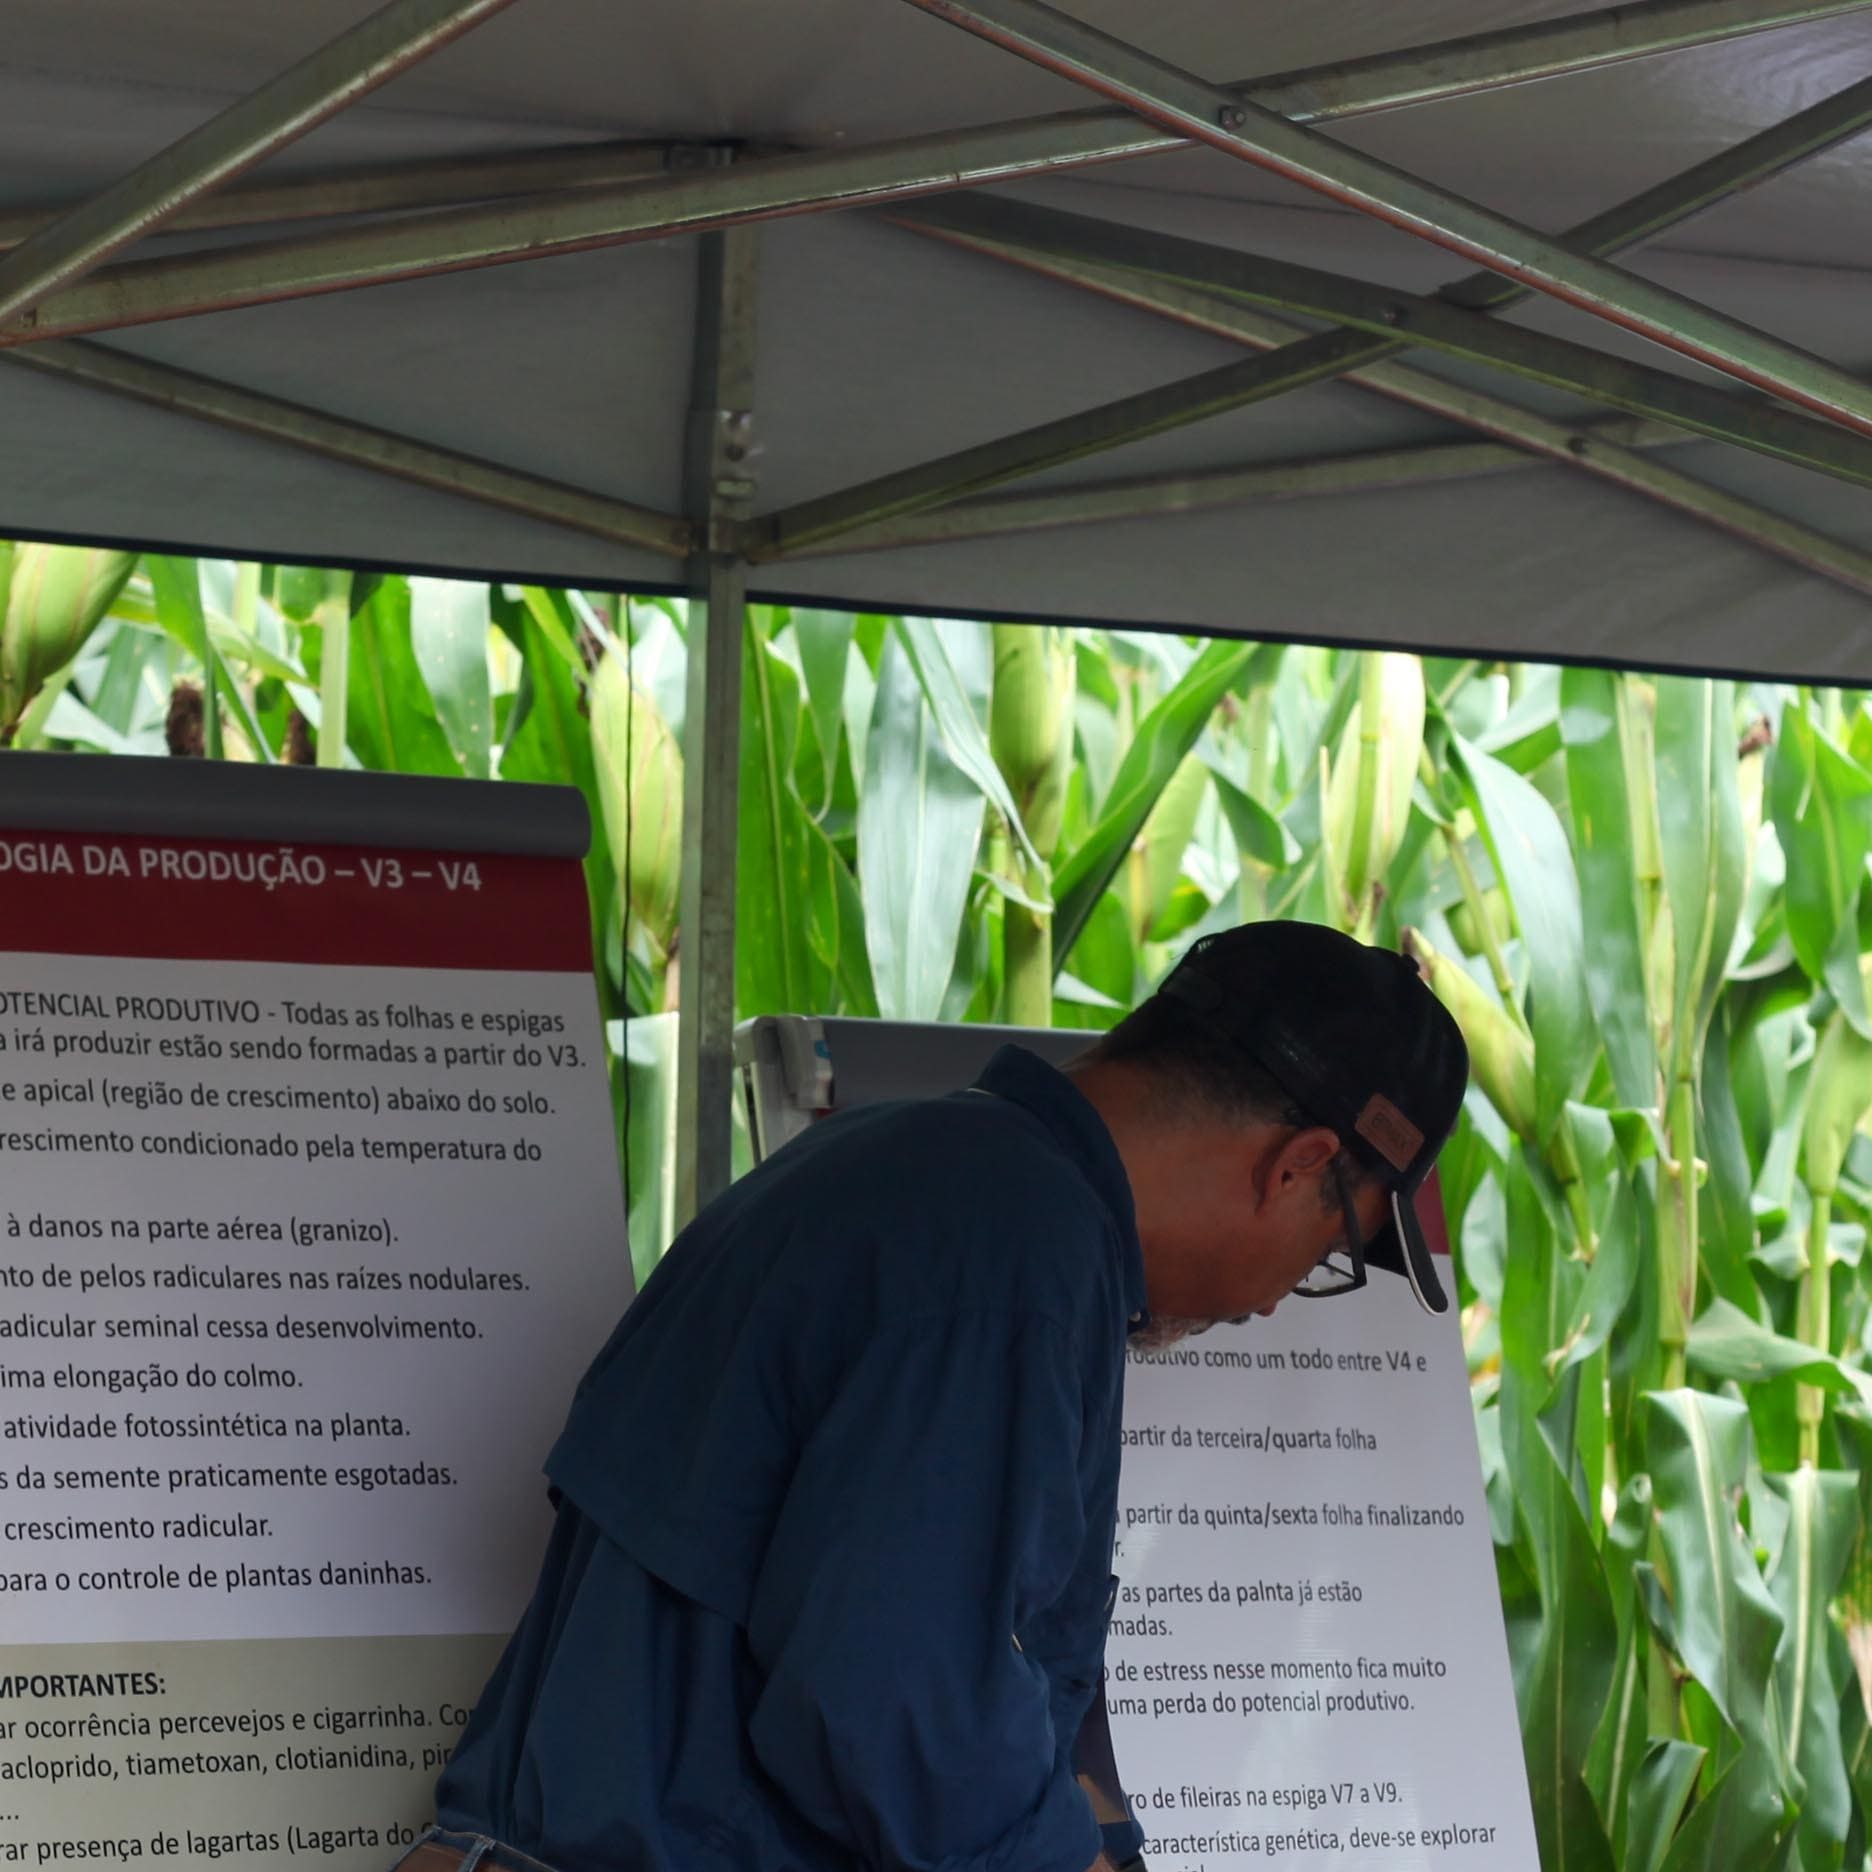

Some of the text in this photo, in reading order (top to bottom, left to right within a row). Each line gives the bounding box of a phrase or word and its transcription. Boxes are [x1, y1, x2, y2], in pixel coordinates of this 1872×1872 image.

[83, 846, 130, 876] DA
[140, 849, 325, 890] PRODUÇÃO
[361, 859, 403, 888] V3
[438, 862, 482, 891] V4
[116, 997, 259, 1023] PRODUTIVO
[281, 1002, 348, 1026] Todas
[356, 1010, 379, 1027] as
[386, 1004, 454, 1029] folhas
[461, 1013, 473, 1030] e
[482, 1010, 564, 1037] espigas
[24, 1079, 94, 1107] apical
[103, 1079, 183, 1109] (região
[191, 1083, 219, 1106] de
[227, 1086, 379, 1114] crescimento)
[388, 1088, 460, 1111] abaixo
[468, 1089, 496, 1112] do
[503, 1091, 555, 1114] solo.
[8, 1213, 20, 1237] à
[29, 1213, 103, 1237] danos
[111, 1221, 139, 1237] na
[148, 1219, 208, 1243] parte
[217, 1216, 282, 1240] aérea
[291, 1216, 398, 1246] (granizo).
[105, 1314, 198, 1337] seminal
[207, 1321, 268, 1338] cessa
[276, 1315, 482, 1338] desenvolvimento.
[54, 1364, 178, 1393] elongação
[187, 1363, 216, 1387] do
[224, 1364, 302, 1387] colmo.
[5, 1414, 116, 1438] atividade
[125, 1413, 286, 1437] fotossintética
[296, 1419, 322, 1436] na
[331, 1413, 410, 1441] planta.
[17, 1465, 45, 1489] da
[54, 1467, 159, 1489] semente
[169, 1464, 327, 1493] praticamente
[335, 1462, 456, 1491] esgotadas.
[5, 1516, 154, 1540] crescimento
[163, 1513, 272, 1537] radicular.
[1127, 1502, 1464, 1530] partir da quinta/sexta folha finalizando
[1116, 1657, 1446, 1681] de estress nesse momento fica muito
[1107, 1690, 1415, 1719] uma perda do potencial produtivo.
[25, 1713, 150, 1738] ocorrência
[160, 1710, 284, 1740] percevejos
[293, 1714, 305, 1730] e
[314, 1704, 432, 1734] cigarrinha.
[126, 1753, 267, 1775] tiametoxan,
[276, 1745, 413, 1770] clotianidina,
[1140, 1824, 1495, 1856] característica genética, deve-se explorar
